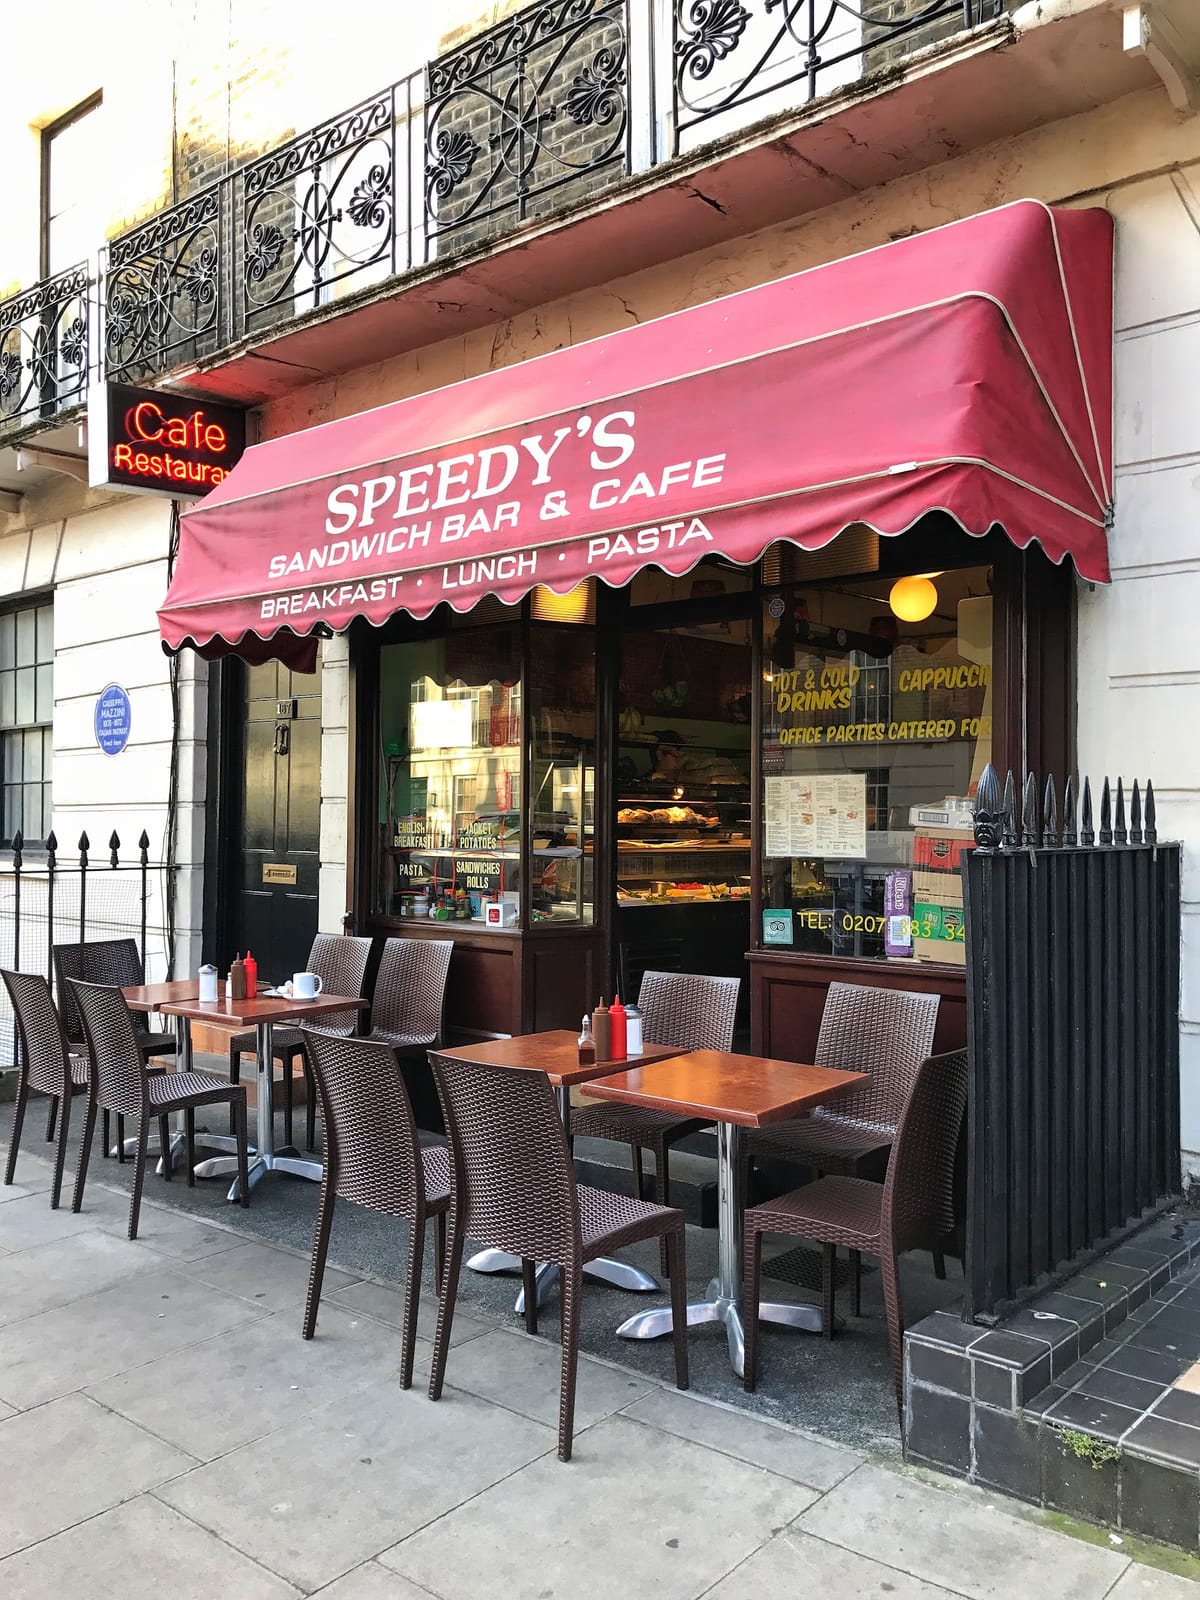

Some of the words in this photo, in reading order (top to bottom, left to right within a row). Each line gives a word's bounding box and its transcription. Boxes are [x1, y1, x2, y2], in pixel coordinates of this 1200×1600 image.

[135, 402, 227, 452] Cafe
[115, 443, 231, 485] Restaura
[325, 410, 636, 535] SPEEDY'S
[268, 521, 431, 579] SANDWICH
[439, 501, 521, 544] BAR
[539, 490, 571, 521] &
[588, 453, 727, 511] CAFE
[260, 576, 403, 619] BREAKFAST
[441, 550, 538, 589] LUNCH
[587, 518, 714, 563] PASTA
[771, 670, 801, 693] HOT
[803, 669, 817, 690] &
[820, 665, 861, 688] COLD
[776, 687, 852, 713] DRINKS
[779, 726, 823, 745] OFFICE
[826, 723, 885, 743] PARTIES
[888, 719, 956, 740] CATERED
[398, 822, 425, 834] ENGLISH
[465, 822, 492, 835] JACKET
[394, 835, 433, 849] BREAKFAST
[460, 837, 497, 849] POTATOES
[399, 863, 423, 876] PASTA
[456, 861, 501, 875] SANDWICHES
[466, 876, 489, 889] ROLLS
[796, 911, 832, 930] TEL:
[843, 914, 886, 933] 0207
